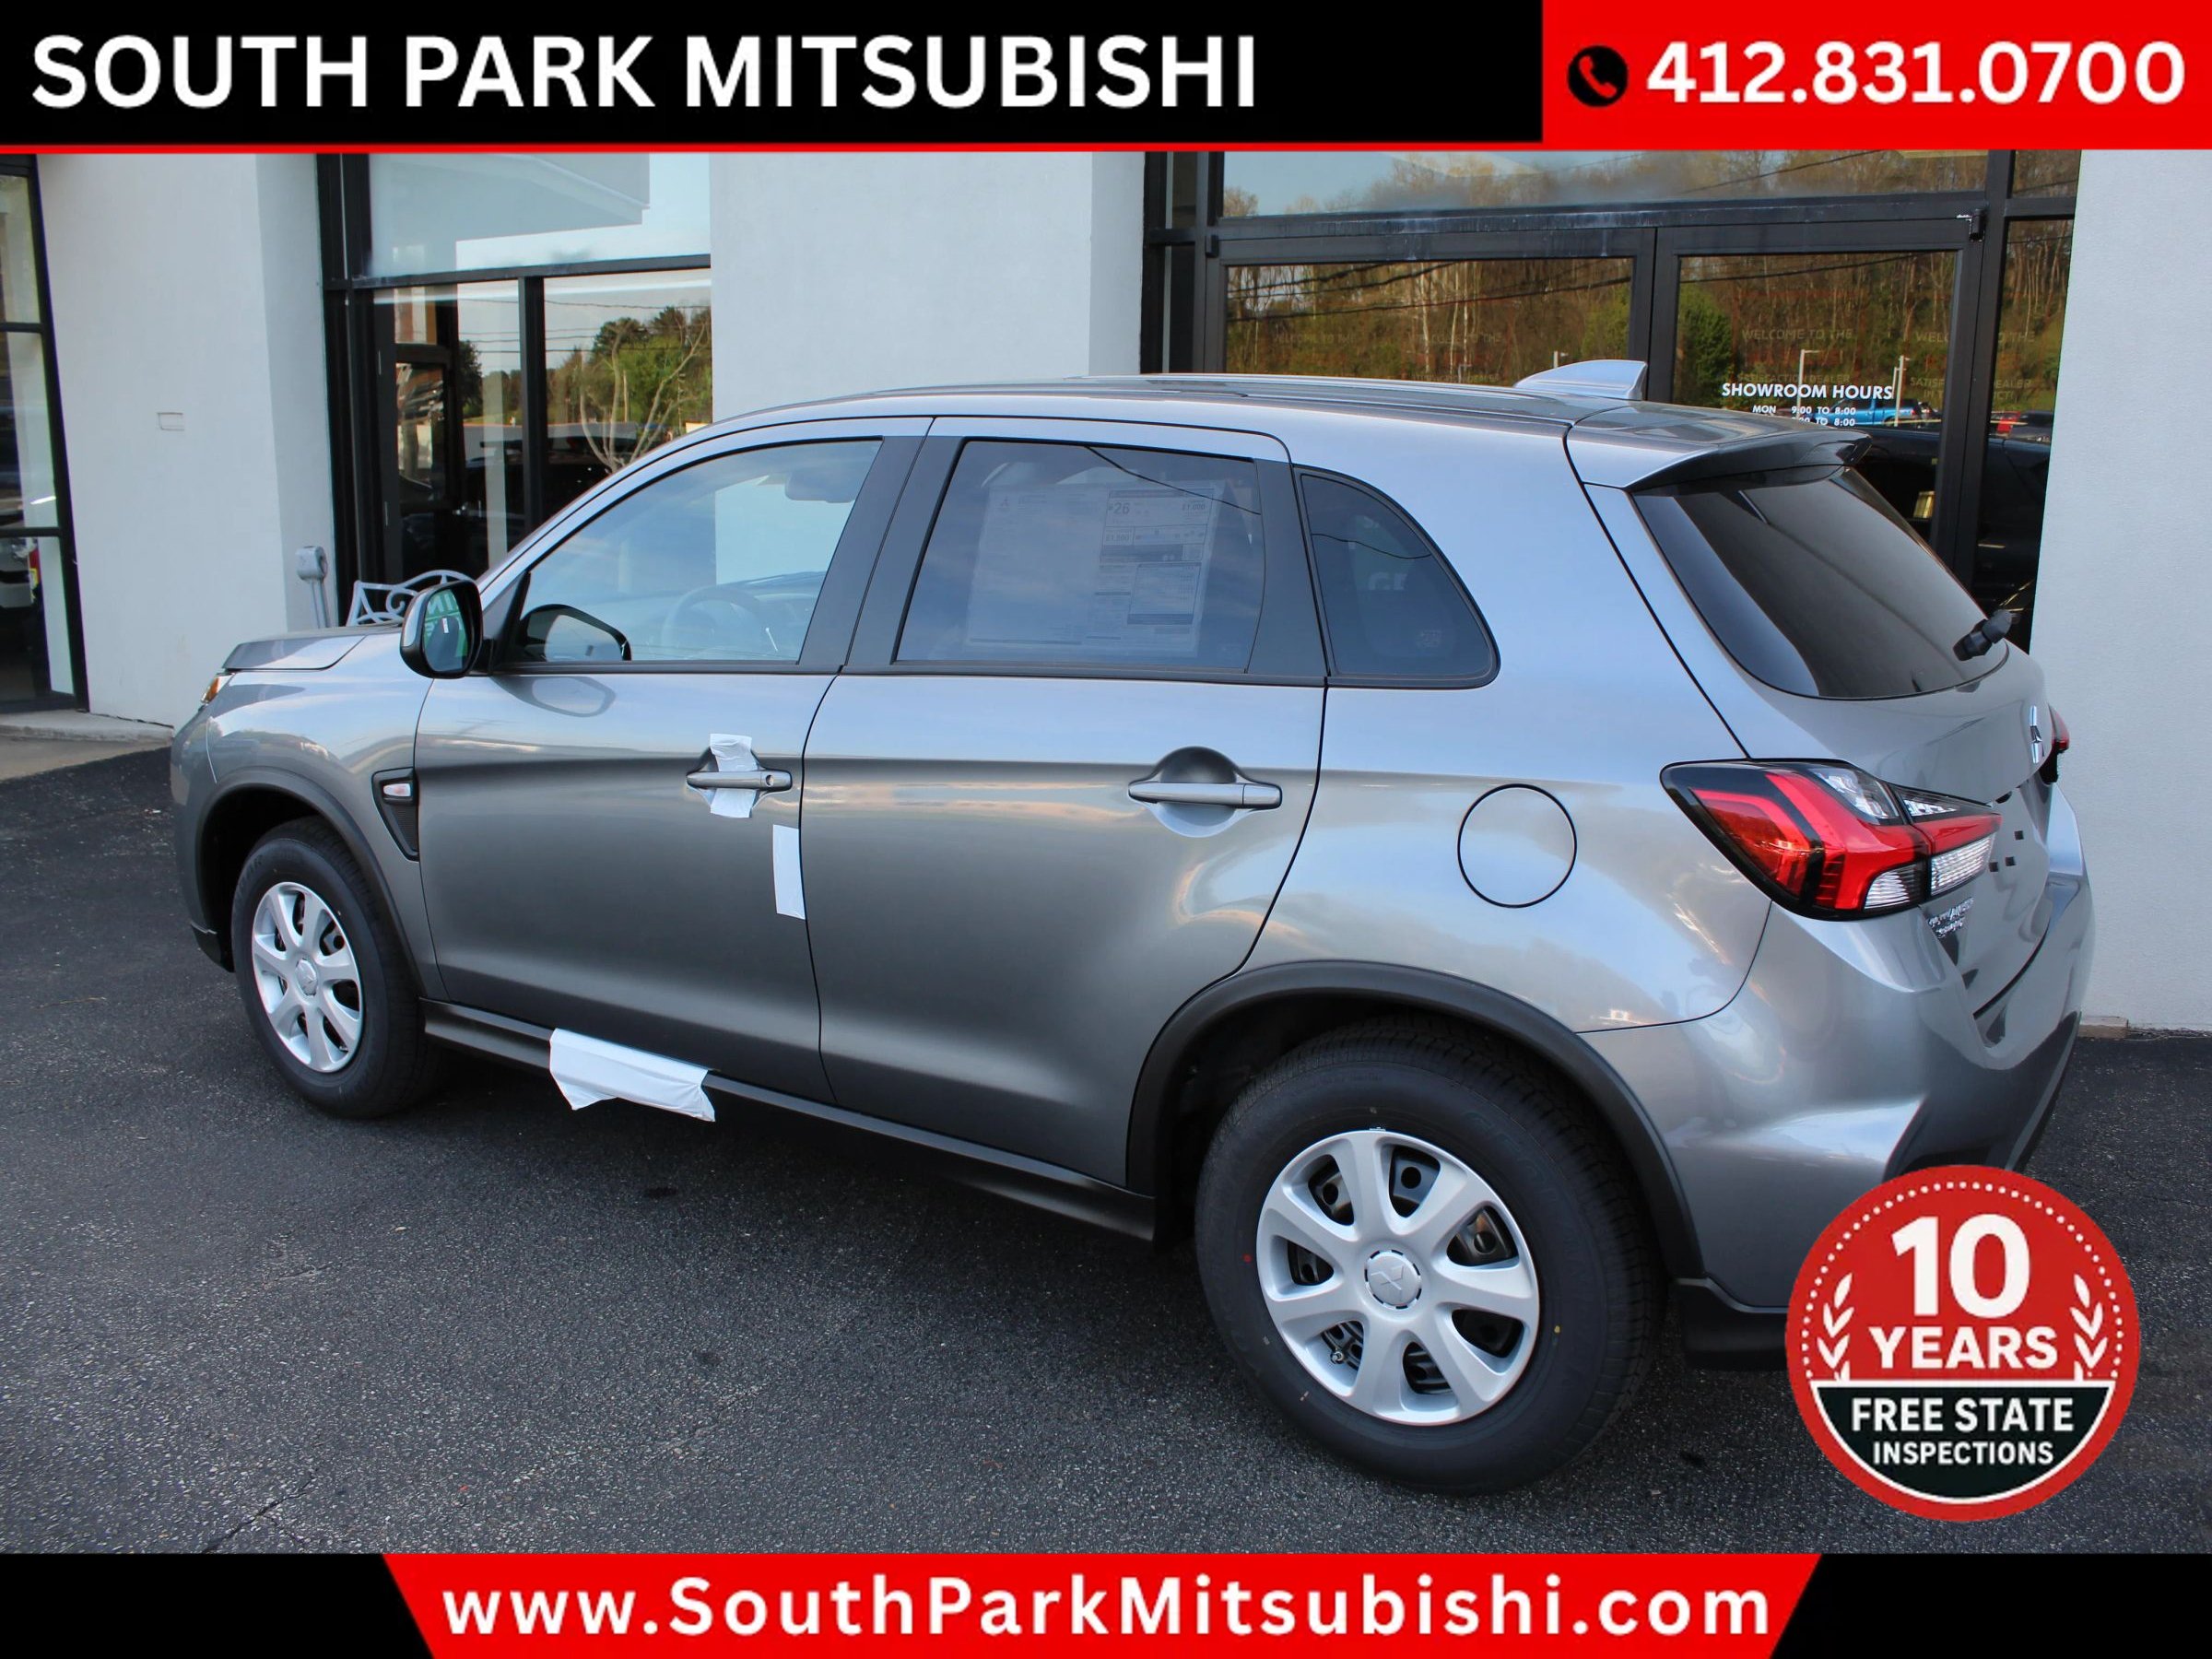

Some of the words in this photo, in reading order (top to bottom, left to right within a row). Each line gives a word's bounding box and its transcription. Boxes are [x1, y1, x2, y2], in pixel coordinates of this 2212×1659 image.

[1721, 382, 1827, 399] SHOWROOM
[1831, 384, 1893, 400] HOURS
[1752, 405, 1776, 414] MON
[1791, 406, 1812, 415] 9:00
[1817, 406, 1830, 415] TO
[1835, 407, 1856, 416] 8:00
[1816, 417, 1829, 426] TO
[1834, 418, 1855, 427] 8:00
